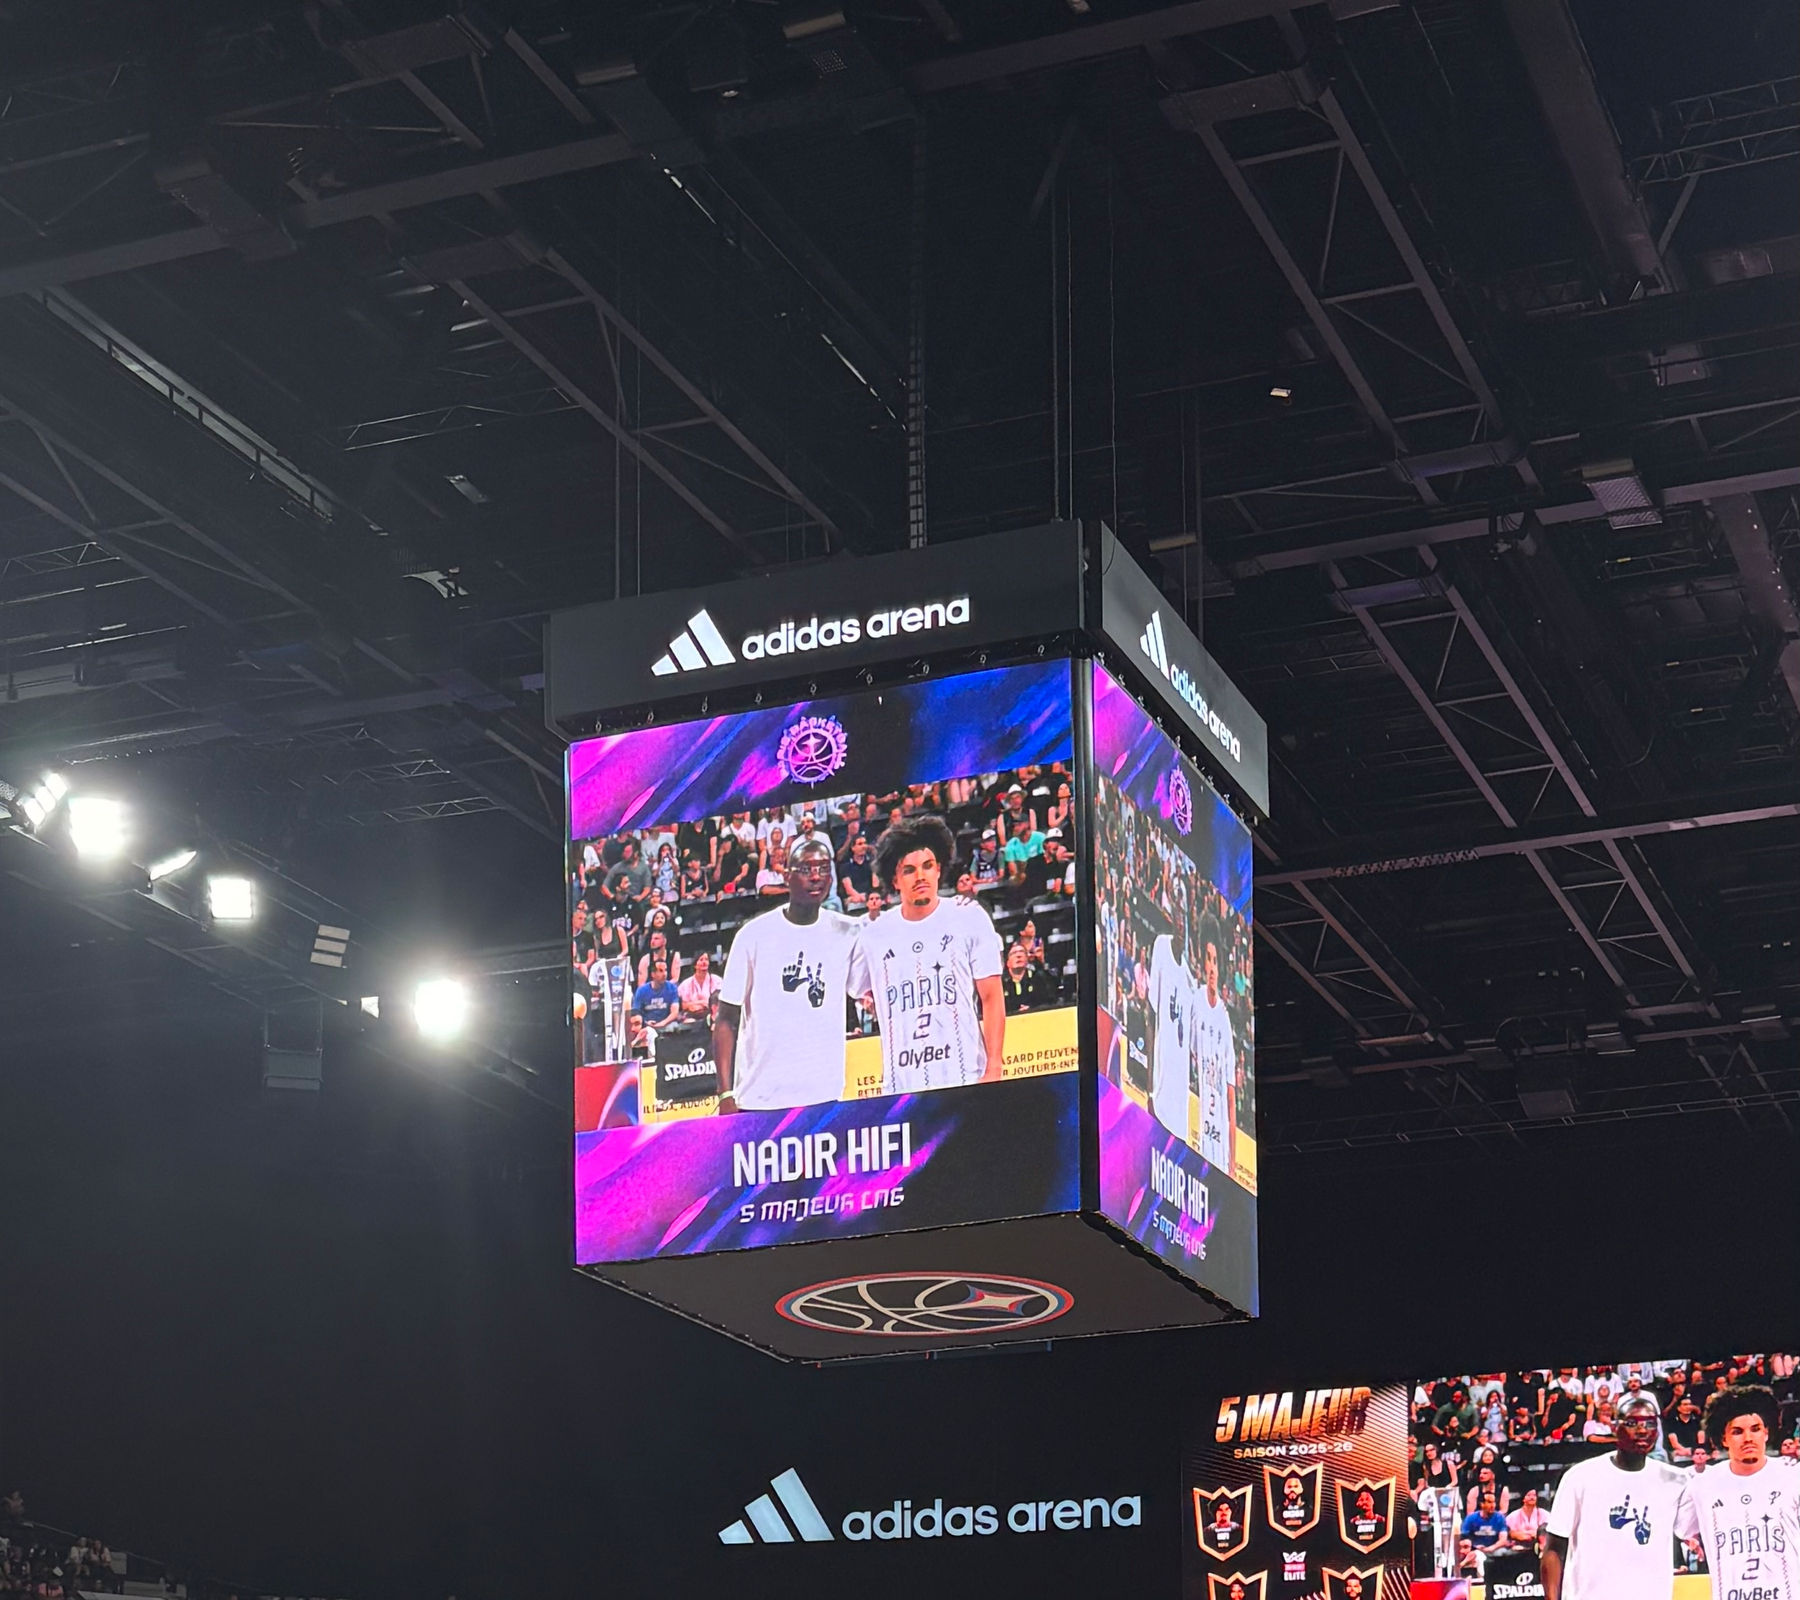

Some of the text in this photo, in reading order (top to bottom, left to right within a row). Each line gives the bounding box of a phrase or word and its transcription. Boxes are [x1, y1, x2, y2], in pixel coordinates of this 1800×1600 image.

[741, 596, 970, 660] adidas arena
[1170, 663, 1241, 763] adidas arena
[887, 975, 957, 1018] PARIS
[913, 1013, 931, 1039] 2
[899, 1044, 951, 1069] OlyBet
[733, 1122, 911, 1187] NADIR HIFI
[1151, 1146, 1209, 1228] NADIR HIFI
[1215, 1387, 1371, 1443] 5 MAJEUR
[1234, 1442, 1353, 1459] SAISON 2025-26
[842, 1495, 1141, 1540] adidas arena
[1714, 1524, 1785, 1560] PARIS
[1741, 1557, 1760, 1580] 2
